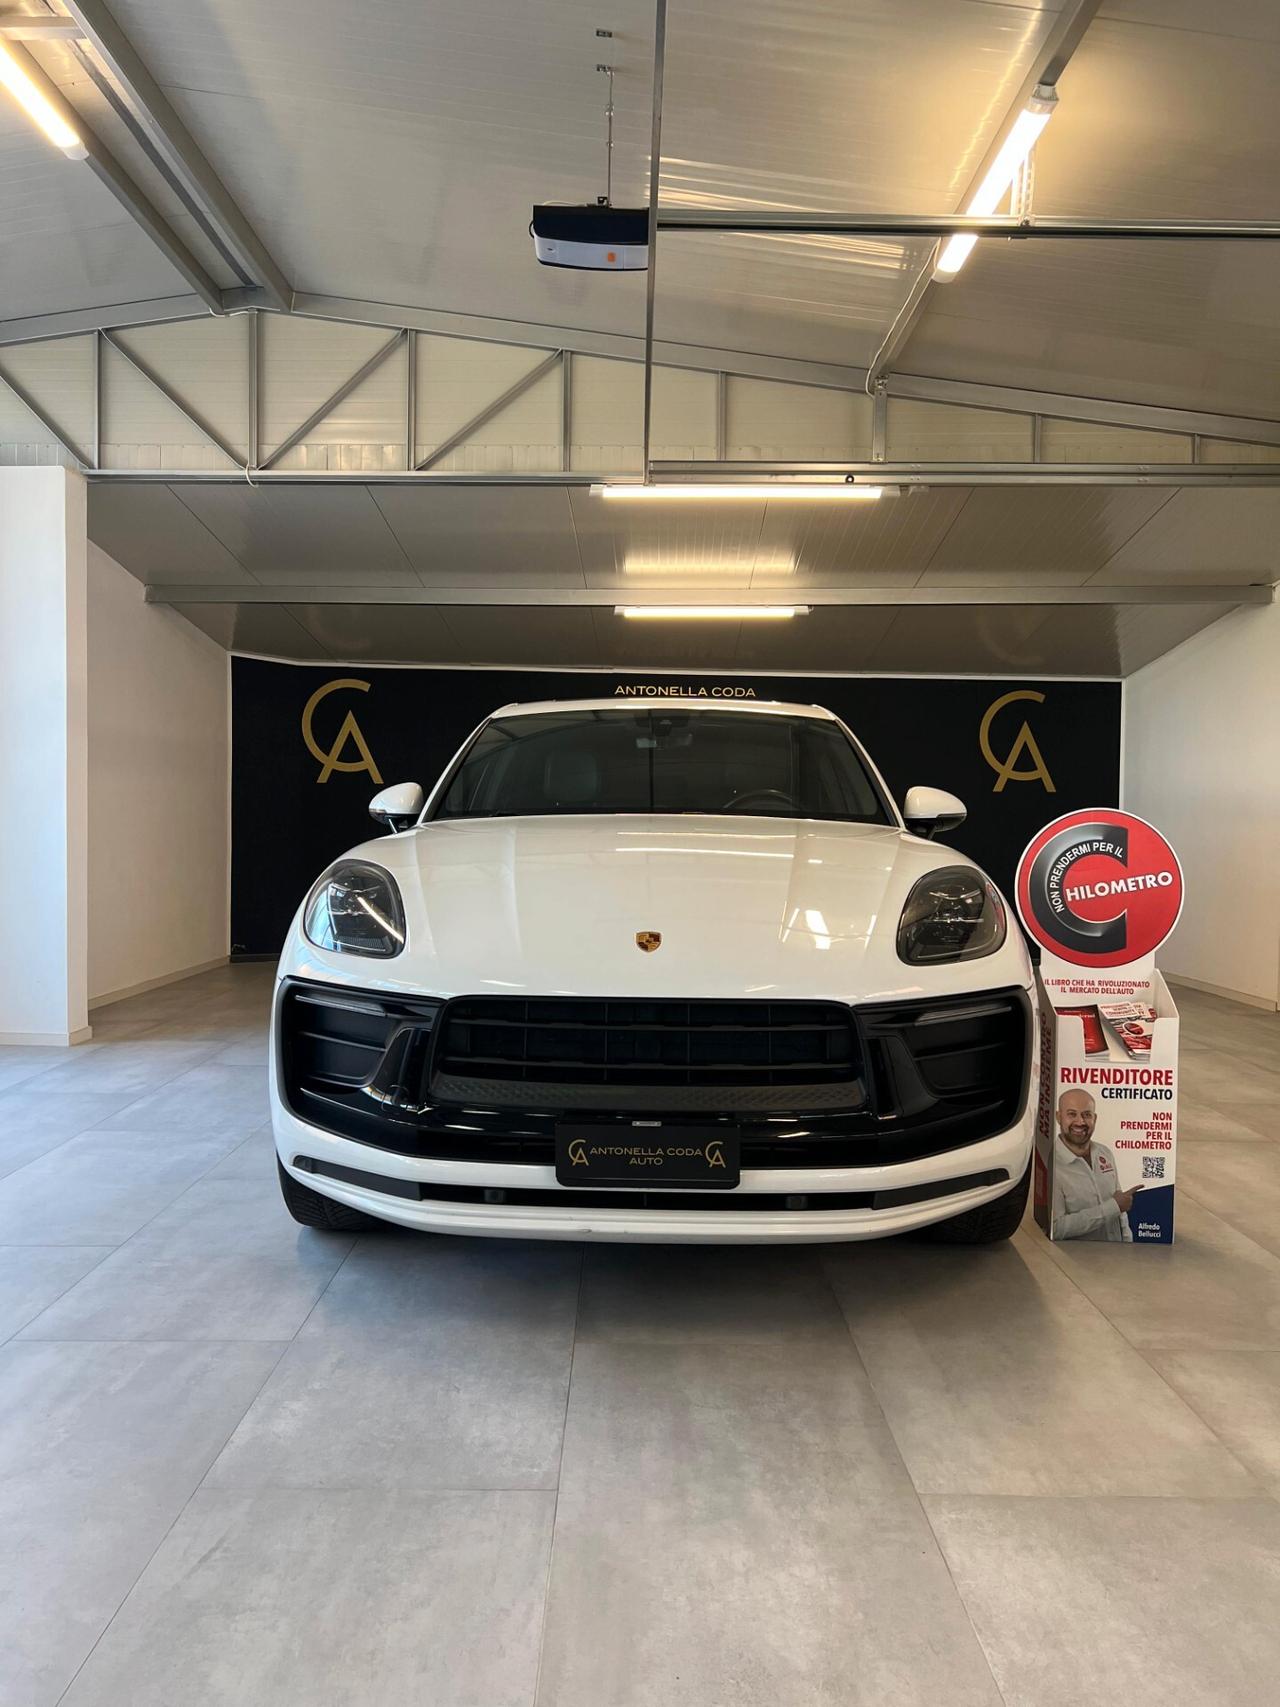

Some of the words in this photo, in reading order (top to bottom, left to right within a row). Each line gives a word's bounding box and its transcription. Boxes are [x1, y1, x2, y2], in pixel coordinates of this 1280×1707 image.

[614, 685, 708, 697] ANTONELLA
[711, 686, 756, 697] CODA
[1093, 842, 1114, 854] PER
[1114, 847, 1124, 858] IL
[1050, 843, 1091, 888] PRENDERMI
[1050, 888, 1064, 913] NON
[1097, 980, 1150, 988] RIVOLUZIONATO
[1100, 987, 1134, 995] DELL'AUTO
[1039, 1011, 1047, 1087] CONTRO
[1044, 1026, 1052, 1104] INSIEME
[1060, 1067, 1173, 1086] RIVENDITORE
[1101, 1087, 1173, 1101] CERTIFICATO
[1152, 1111, 1173, 1121] NON
[1044, 1110, 1050, 1140] MA
[1120, 1121, 1172, 1131] PRENDERMI
[1146, 1131, 1163, 1140] PER
[1164, 1131, 1172, 1140] IL
[1115, 1140, 1172, 1150] CHILOMETRO
[589, 1147, 665, 1156] ANTONELLA
[666, 1147, 703, 1156] CODA
[629, 1157, 664, 1166] AUTO
[1138, 1222, 1160, 1230] Alfredo
[1138, 1230, 1161, 1238] Bellucci
